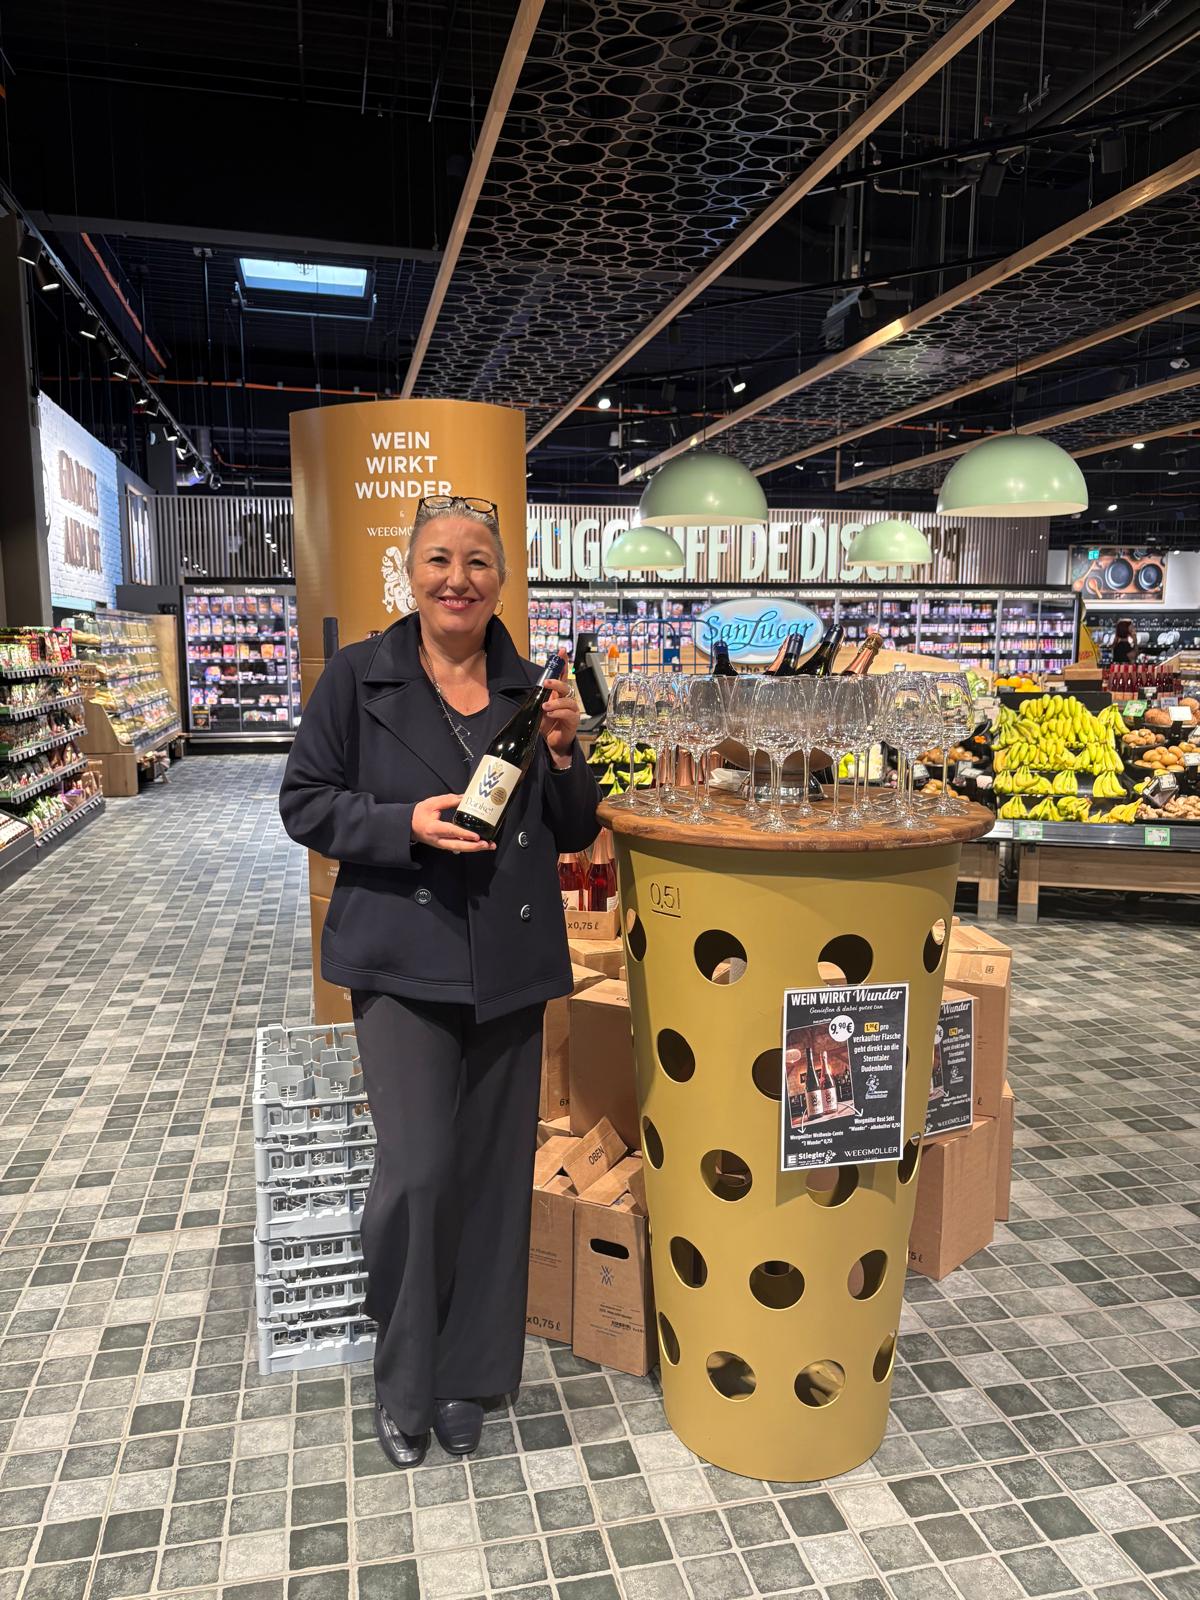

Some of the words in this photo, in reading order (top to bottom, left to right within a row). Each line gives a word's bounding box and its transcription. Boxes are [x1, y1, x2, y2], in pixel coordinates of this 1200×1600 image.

[371, 431, 430, 450] WEIN
[366, 455, 438, 474] WIRKT
[354, 480, 452, 499] WUNDER
[741, 522, 789, 580] DE
[703, 611, 813, 651] SanLucar
[791, 993, 817, 1006] WEIN
[819, 991, 851, 1004] WIRKT
[853, 989, 903, 1002] Wunder
[881, 1033, 902, 1041] Flasche
[854, 1046, 866, 1054] geht
[866, 1044, 883, 1053] direkt
[588, 1145, 605, 1165] OBEN
[798, 1151, 826, 1160] Stiegler
